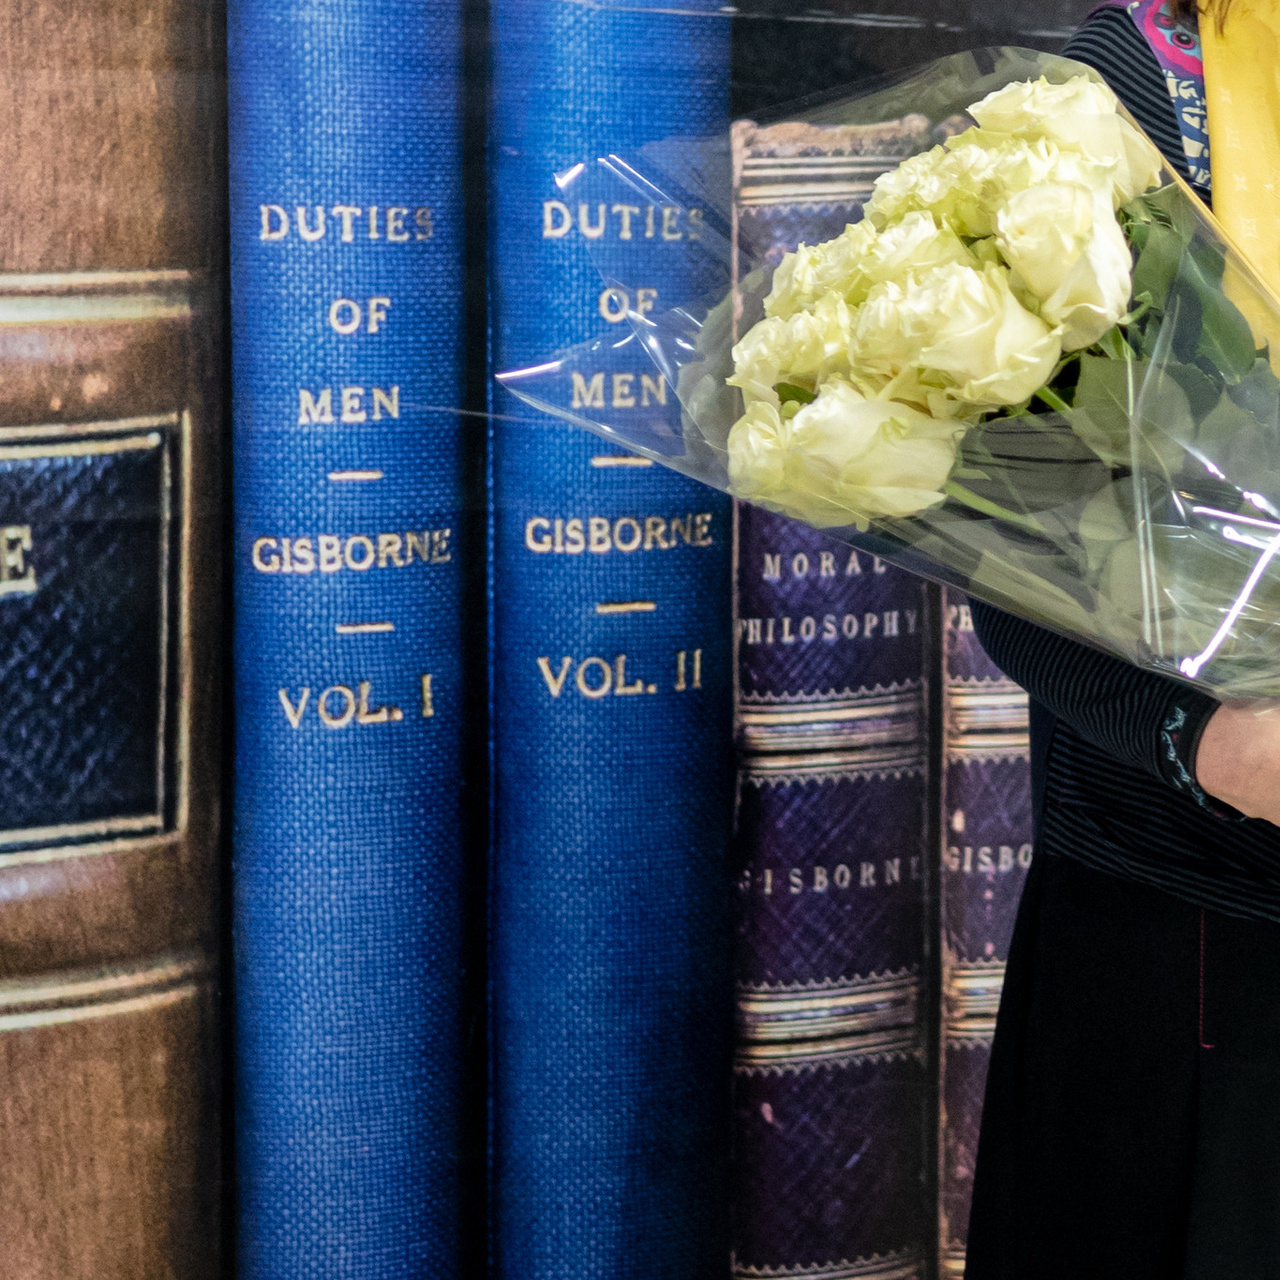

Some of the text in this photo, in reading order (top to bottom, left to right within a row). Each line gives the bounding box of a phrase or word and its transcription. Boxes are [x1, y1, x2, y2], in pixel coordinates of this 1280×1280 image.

[259, 204, 434, 243] DUTIES
[542, 200, 705, 240] DUTIES
[328, 297, 392, 334] OF
[598, 287, 659, 324] OF
[297, 386, 401, 425] MEN
[571, 372, 668, 410] MEN
[252, 529, 452, 575] GISBORNE
[524, 513, 713, 554] GISBORNE
[763, 551, 886, 581] MORAL
[537, 649, 703, 699] VOL. II
[278, 674, 436, 729] VOL. I
